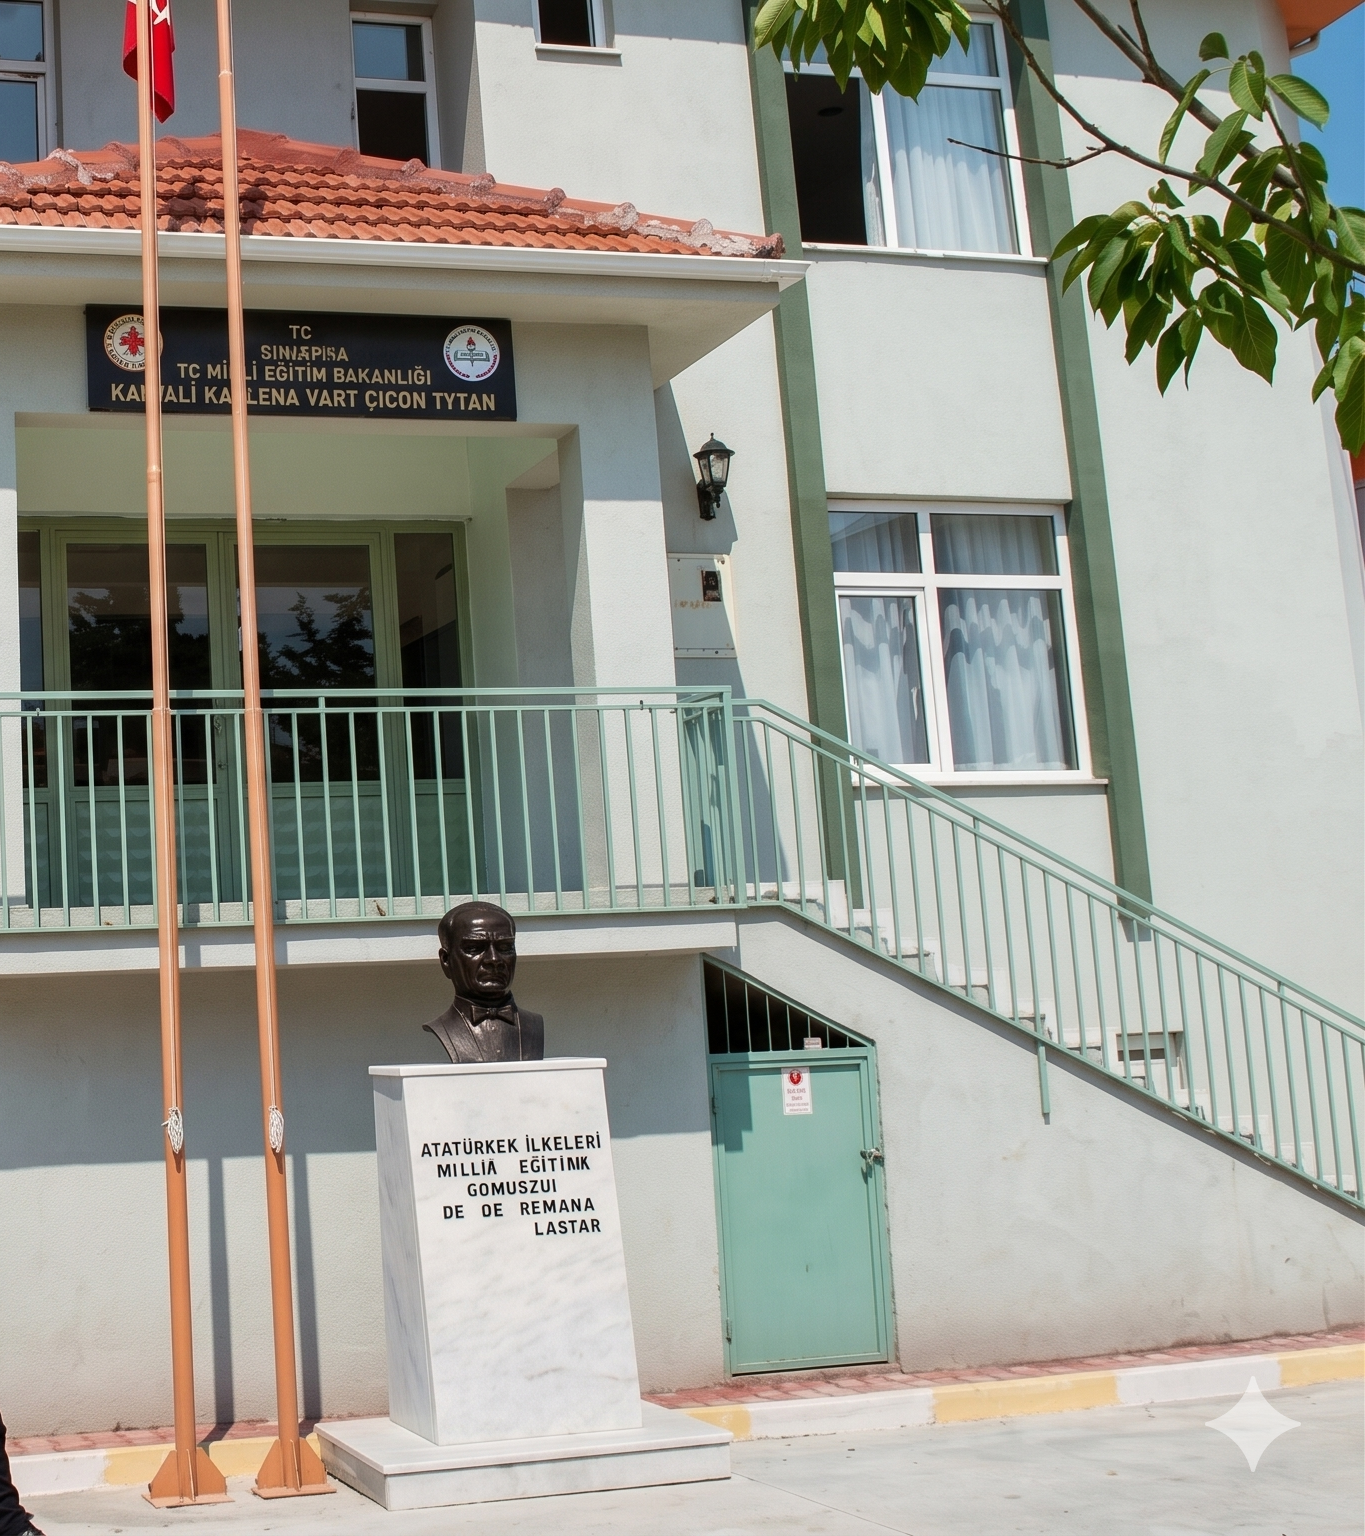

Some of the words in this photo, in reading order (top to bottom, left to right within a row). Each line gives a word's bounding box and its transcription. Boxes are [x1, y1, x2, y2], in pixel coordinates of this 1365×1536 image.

[289, 325, 312, 340] TC
[177, 363, 201, 379] TC
[265, 361, 326, 382] EĞİTİM
[333, 365, 431, 385] BAKANLIĞI
[305, 388, 358, 407] VART
[364, 390, 426, 411] ÇICON
[432, 392, 496, 411] TYTAN
[421, 1138, 519, 1157] ATATÜRKEK
[525, 1131, 601, 1153] İLKELERİ
[467, 1178, 557, 1197] GOMUSZUI
[443, 1205, 465, 1219] DE
[481, 1203, 504, 1217] OE
[520, 1197, 595, 1215] REMANA
[534, 1218, 601, 1236] LASTAR
